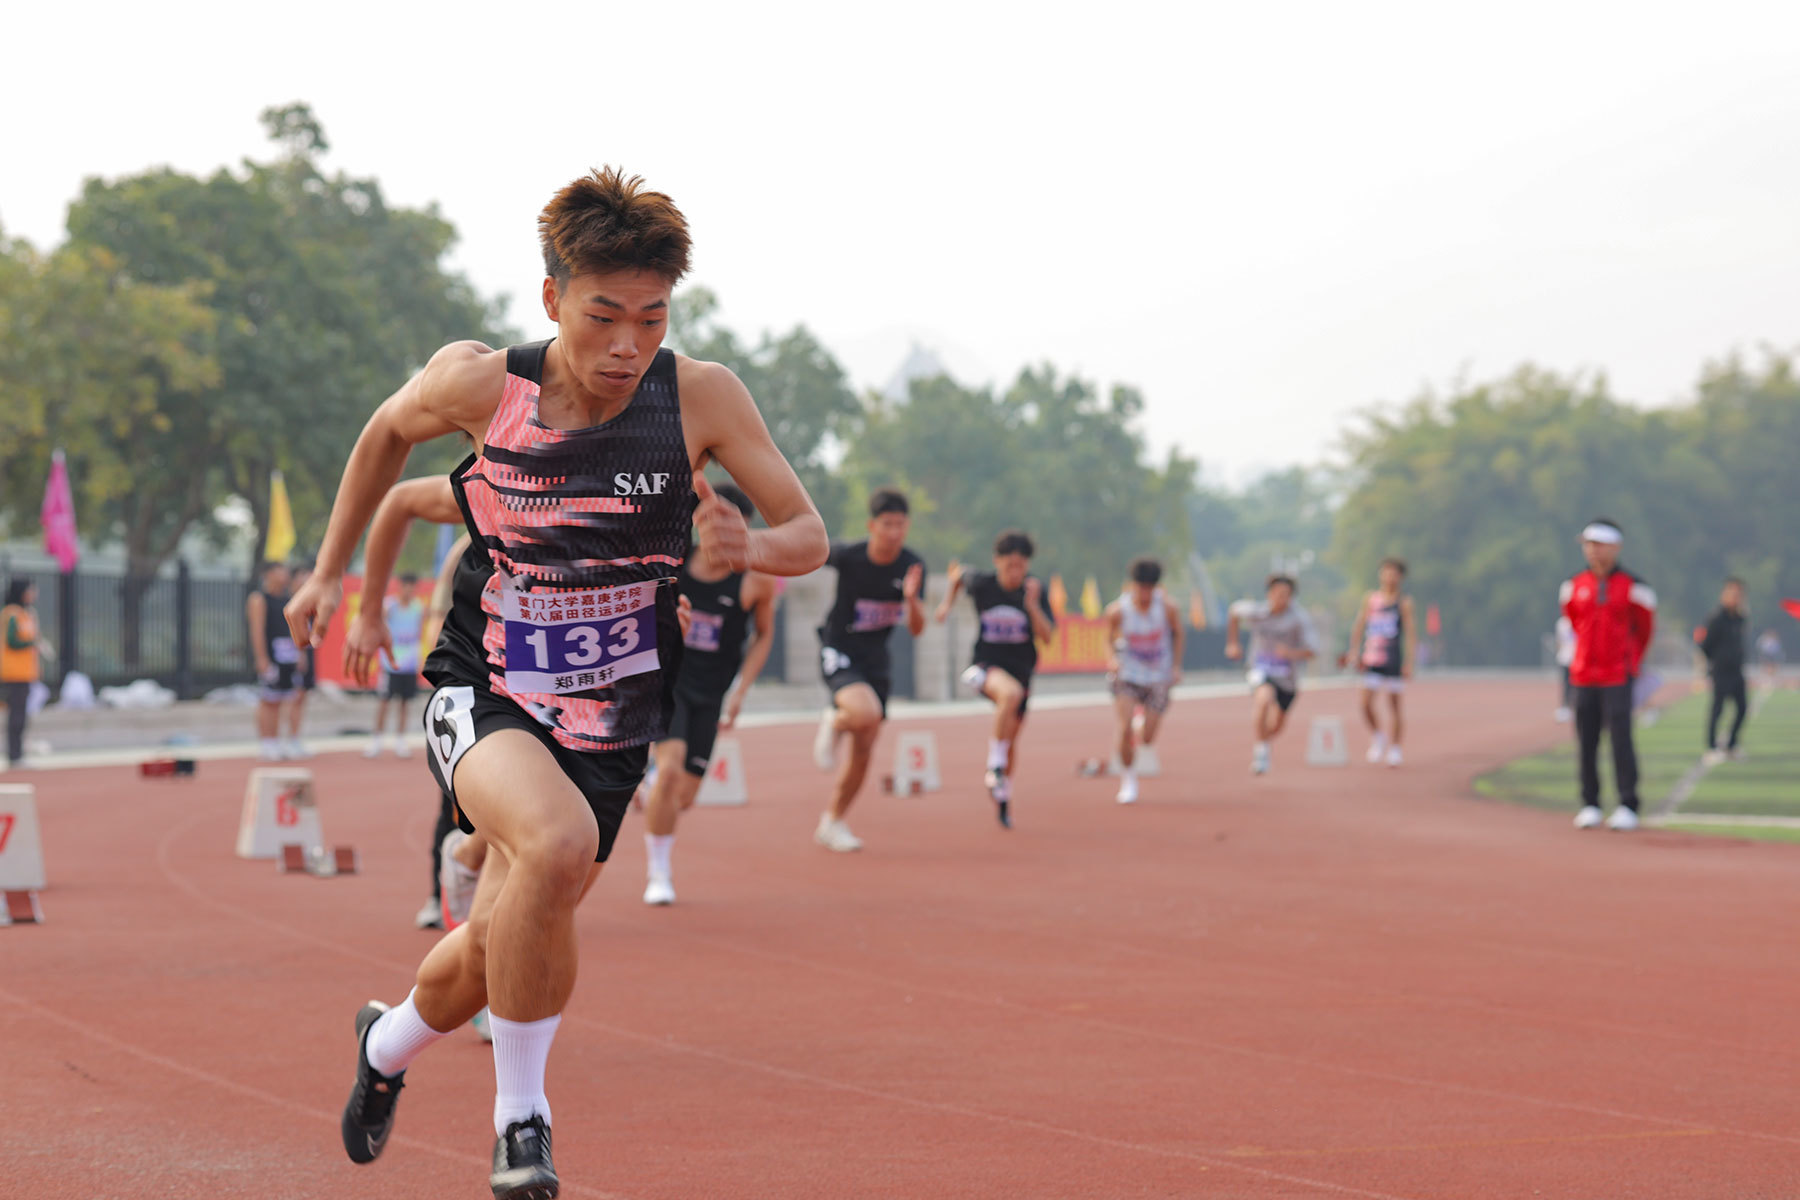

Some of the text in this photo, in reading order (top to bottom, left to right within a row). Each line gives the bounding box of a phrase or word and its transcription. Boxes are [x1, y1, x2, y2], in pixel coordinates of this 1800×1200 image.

[614, 472, 670, 496] SAF
[518, 586, 642, 610] 厦门大学嘉庚学院
[520, 599, 642, 623] 第八届田径运动会
[525, 617, 640, 670] 133
[554, 666, 616, 690] 郑雨轩
[710, 758, 728, 783] 4
